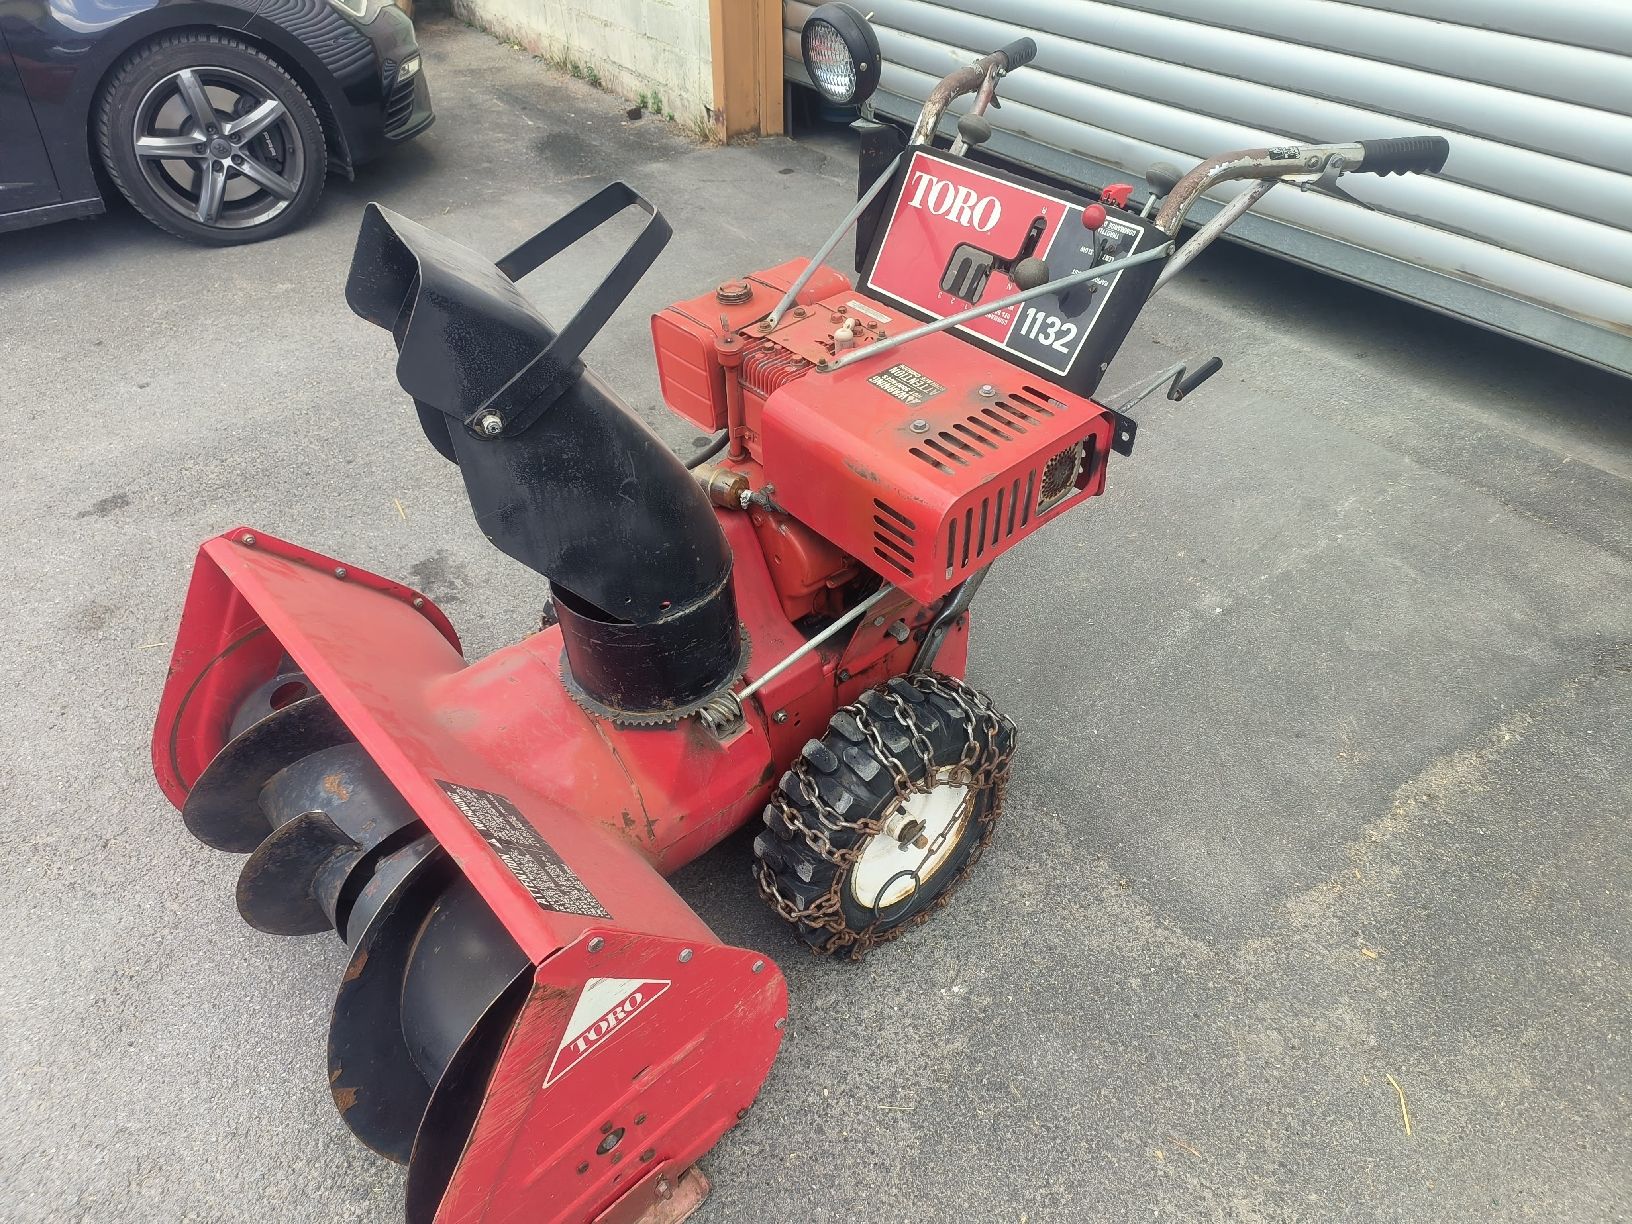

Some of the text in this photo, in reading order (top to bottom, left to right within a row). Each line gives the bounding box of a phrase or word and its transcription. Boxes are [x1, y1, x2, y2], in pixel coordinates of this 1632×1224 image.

[908, 171, 1002, 232] TORO
[1019, 307, 1078, 354] 1132
[866, 375, 909, 400] WARNING
[889, 366, 940, 396] ATTENTION
[447, 791, 550, 906] WARNING ATTENTION
[570, 992, 643, 1054] TORO
